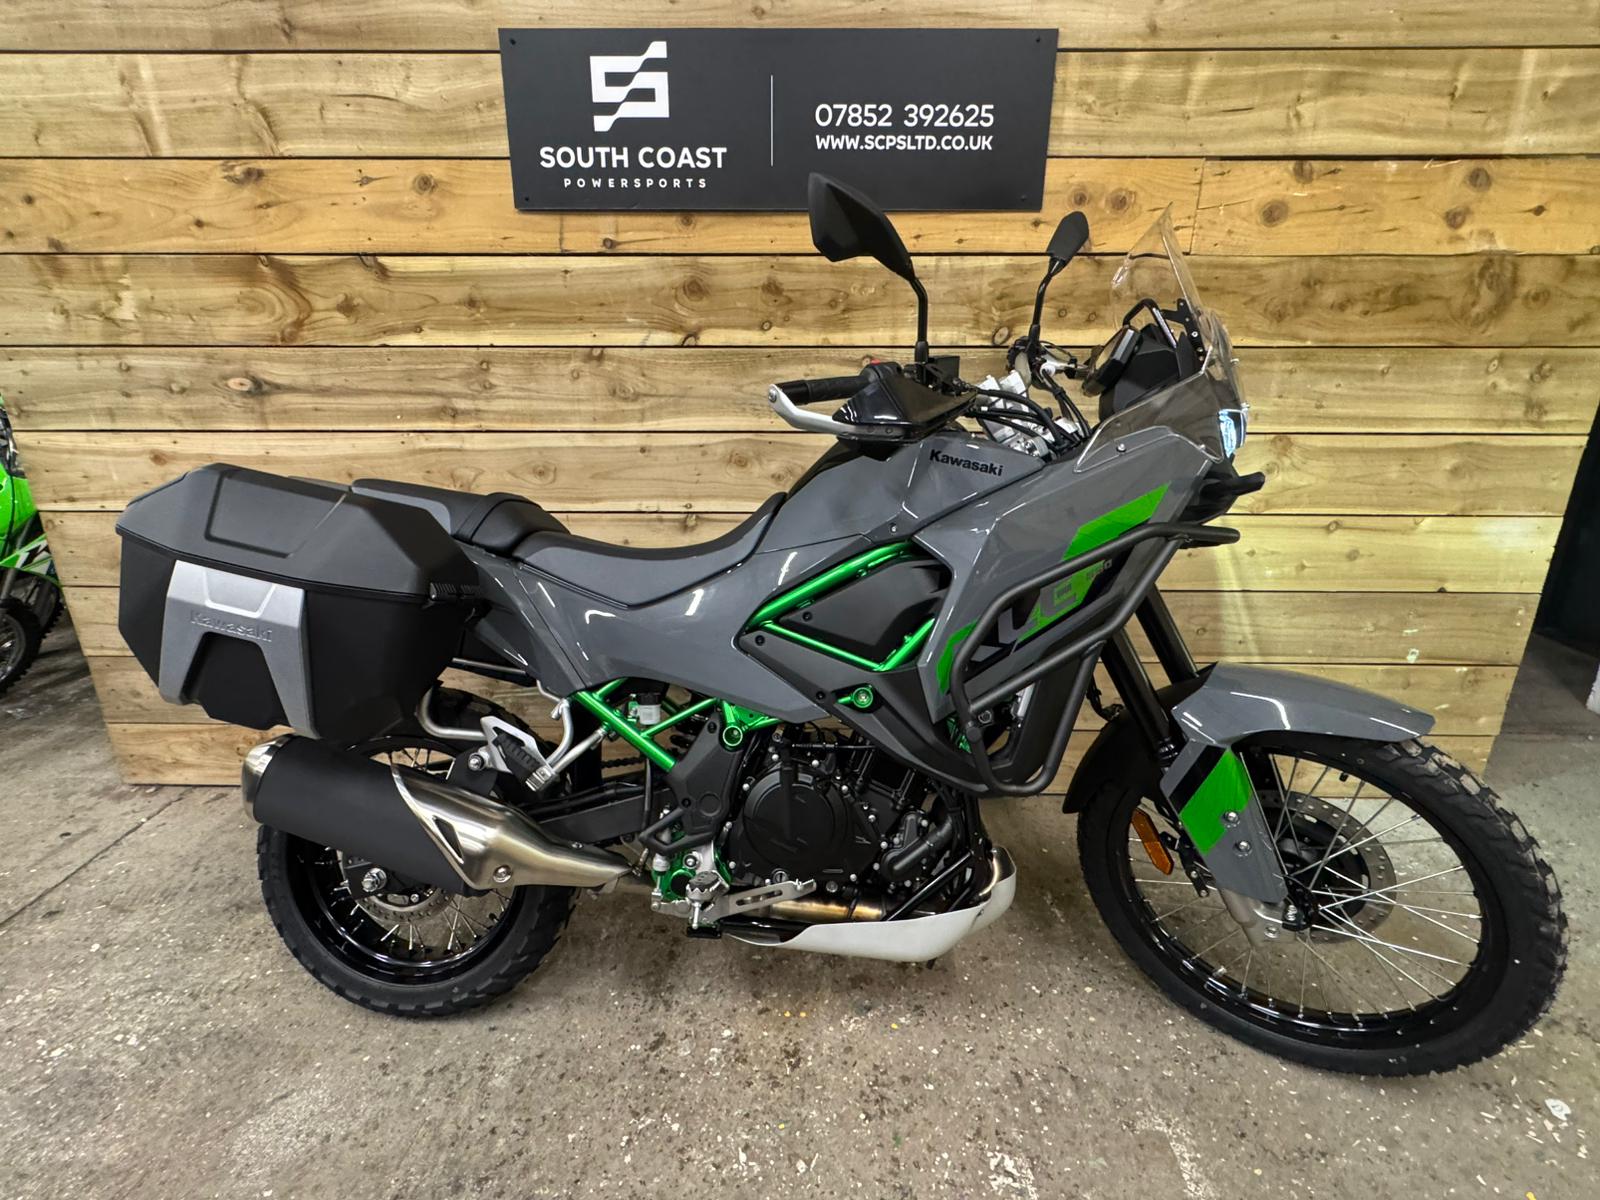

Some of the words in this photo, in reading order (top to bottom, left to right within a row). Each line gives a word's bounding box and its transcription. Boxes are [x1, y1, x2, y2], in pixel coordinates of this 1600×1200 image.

[815, 103, 892, 127] 07852
[904, 103, 994, 127] 392625
[816, 135, 993, 151] WWW.SCPSLTD.CO.UK
[540, 147, 628, 169] SOUTH
[638, 147, 727, 169] COAST
[563, 178, 706, 189] POWERSPORTS
[929, 449, 1003, 476] Kawasaki
[191, 610, 271, 642] Kawasaki
